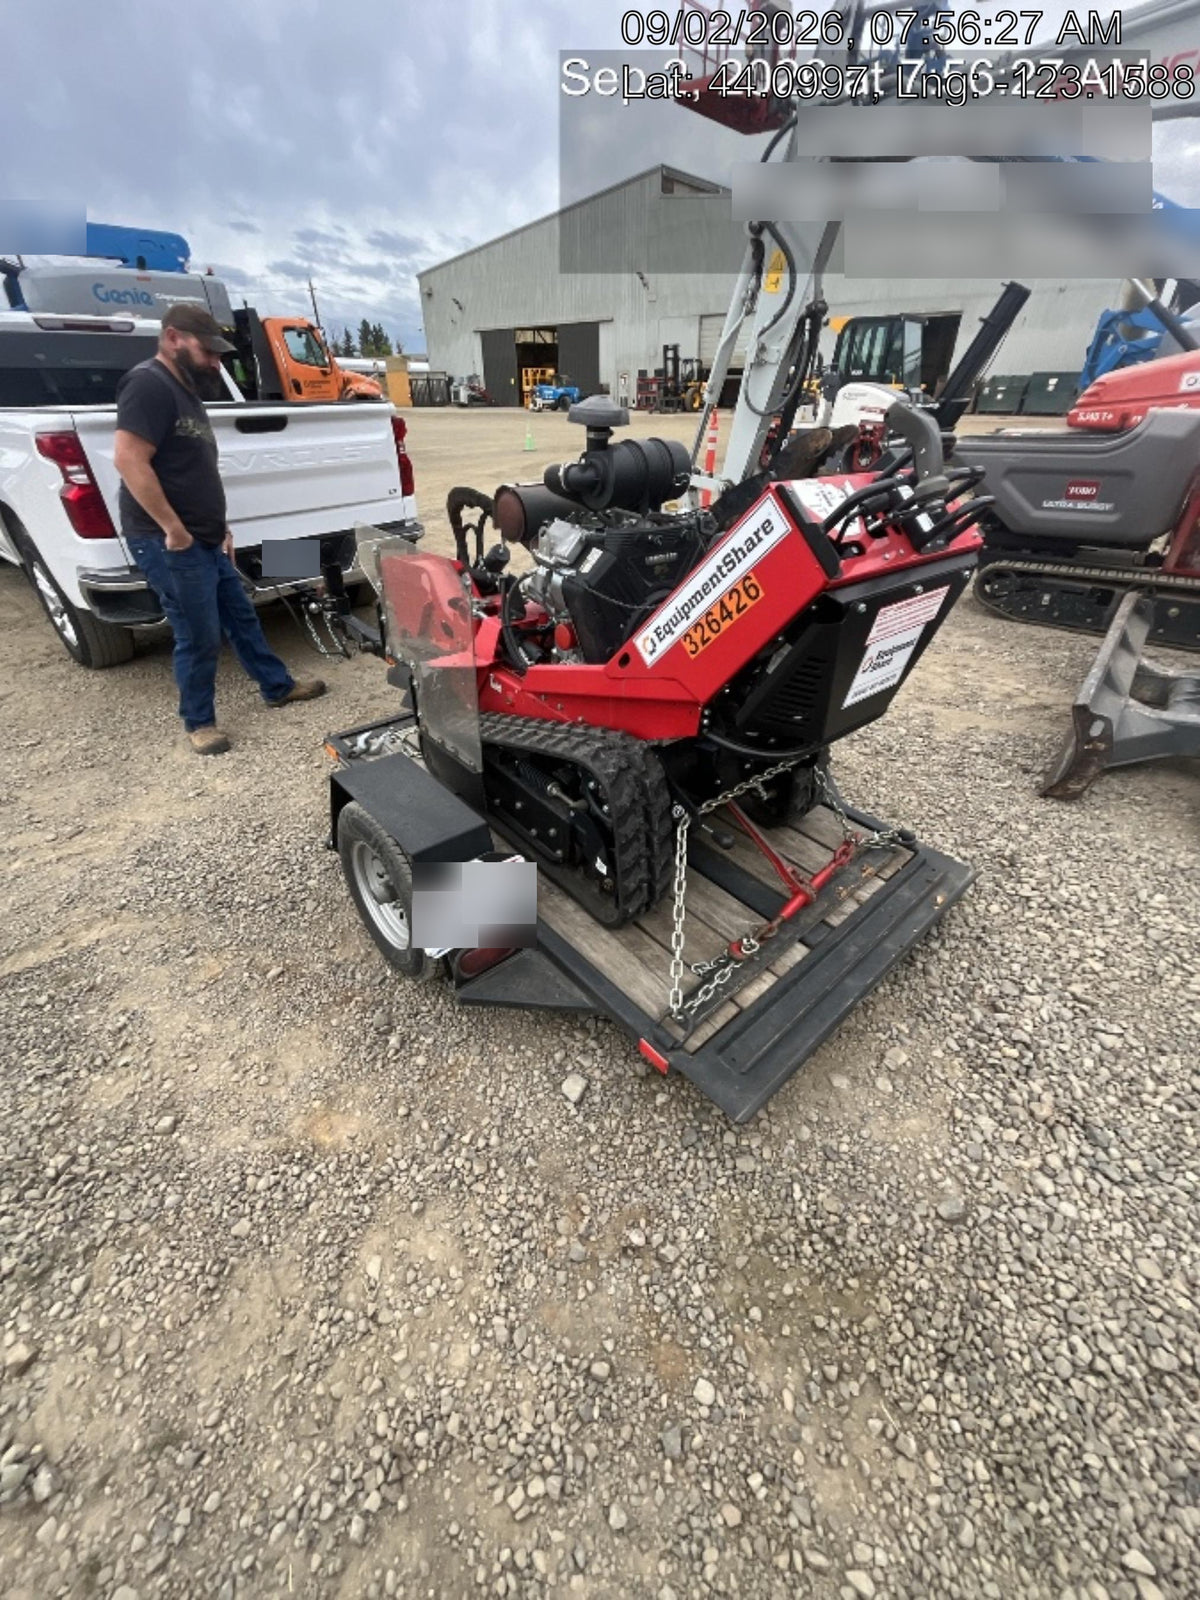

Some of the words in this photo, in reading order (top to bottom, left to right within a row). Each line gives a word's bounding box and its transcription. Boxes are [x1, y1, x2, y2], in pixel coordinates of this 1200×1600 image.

[92, 282, 155, 306] Genie
[653, 517, 775, 645] EquipmentShare
[683, 574, 761, 656] 326426
